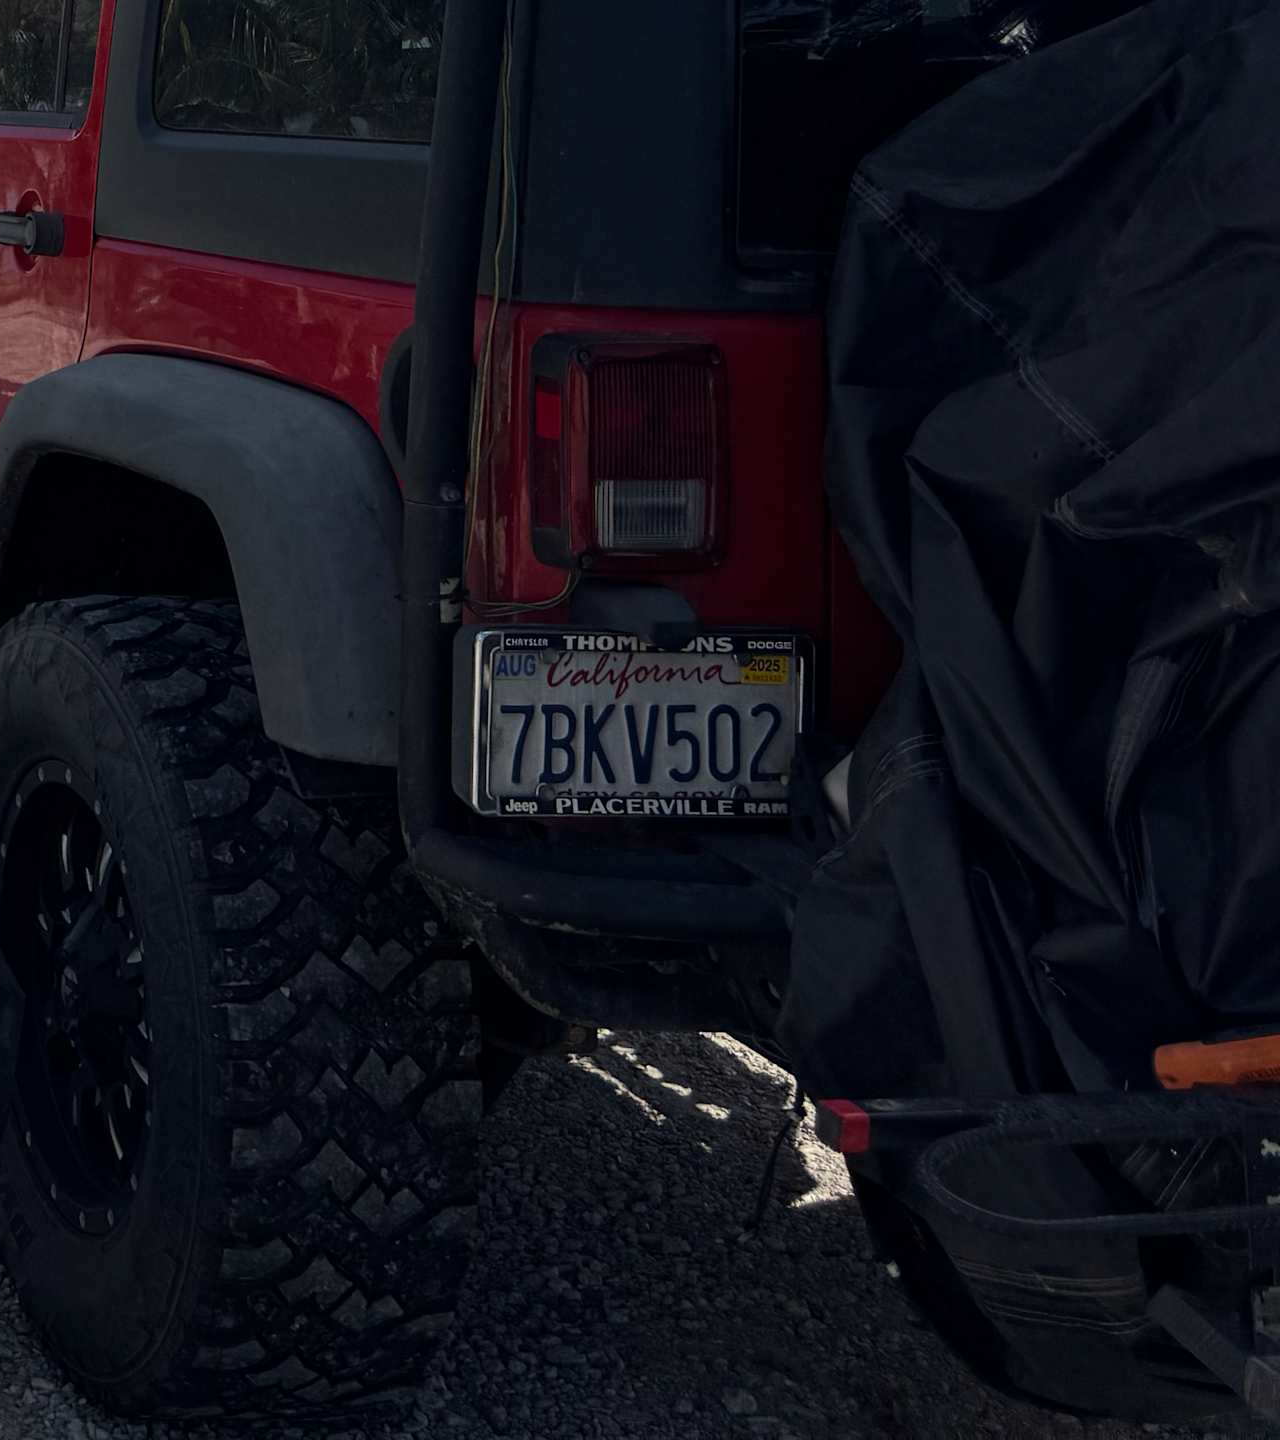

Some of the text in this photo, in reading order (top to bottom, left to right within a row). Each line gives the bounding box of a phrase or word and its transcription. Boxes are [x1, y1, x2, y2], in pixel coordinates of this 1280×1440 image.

[505, 635, 793, 653] CHRYSLER THOMONS DODGE
[496, 654, 536, 677] AUG
[546, 652, 740, 699] California
[750, 658, 781, 673] 2025
[499, 703, 790, 785] 7BKV502
[505, 797, 789, 816] Jeep PLACERVILLE RAM
